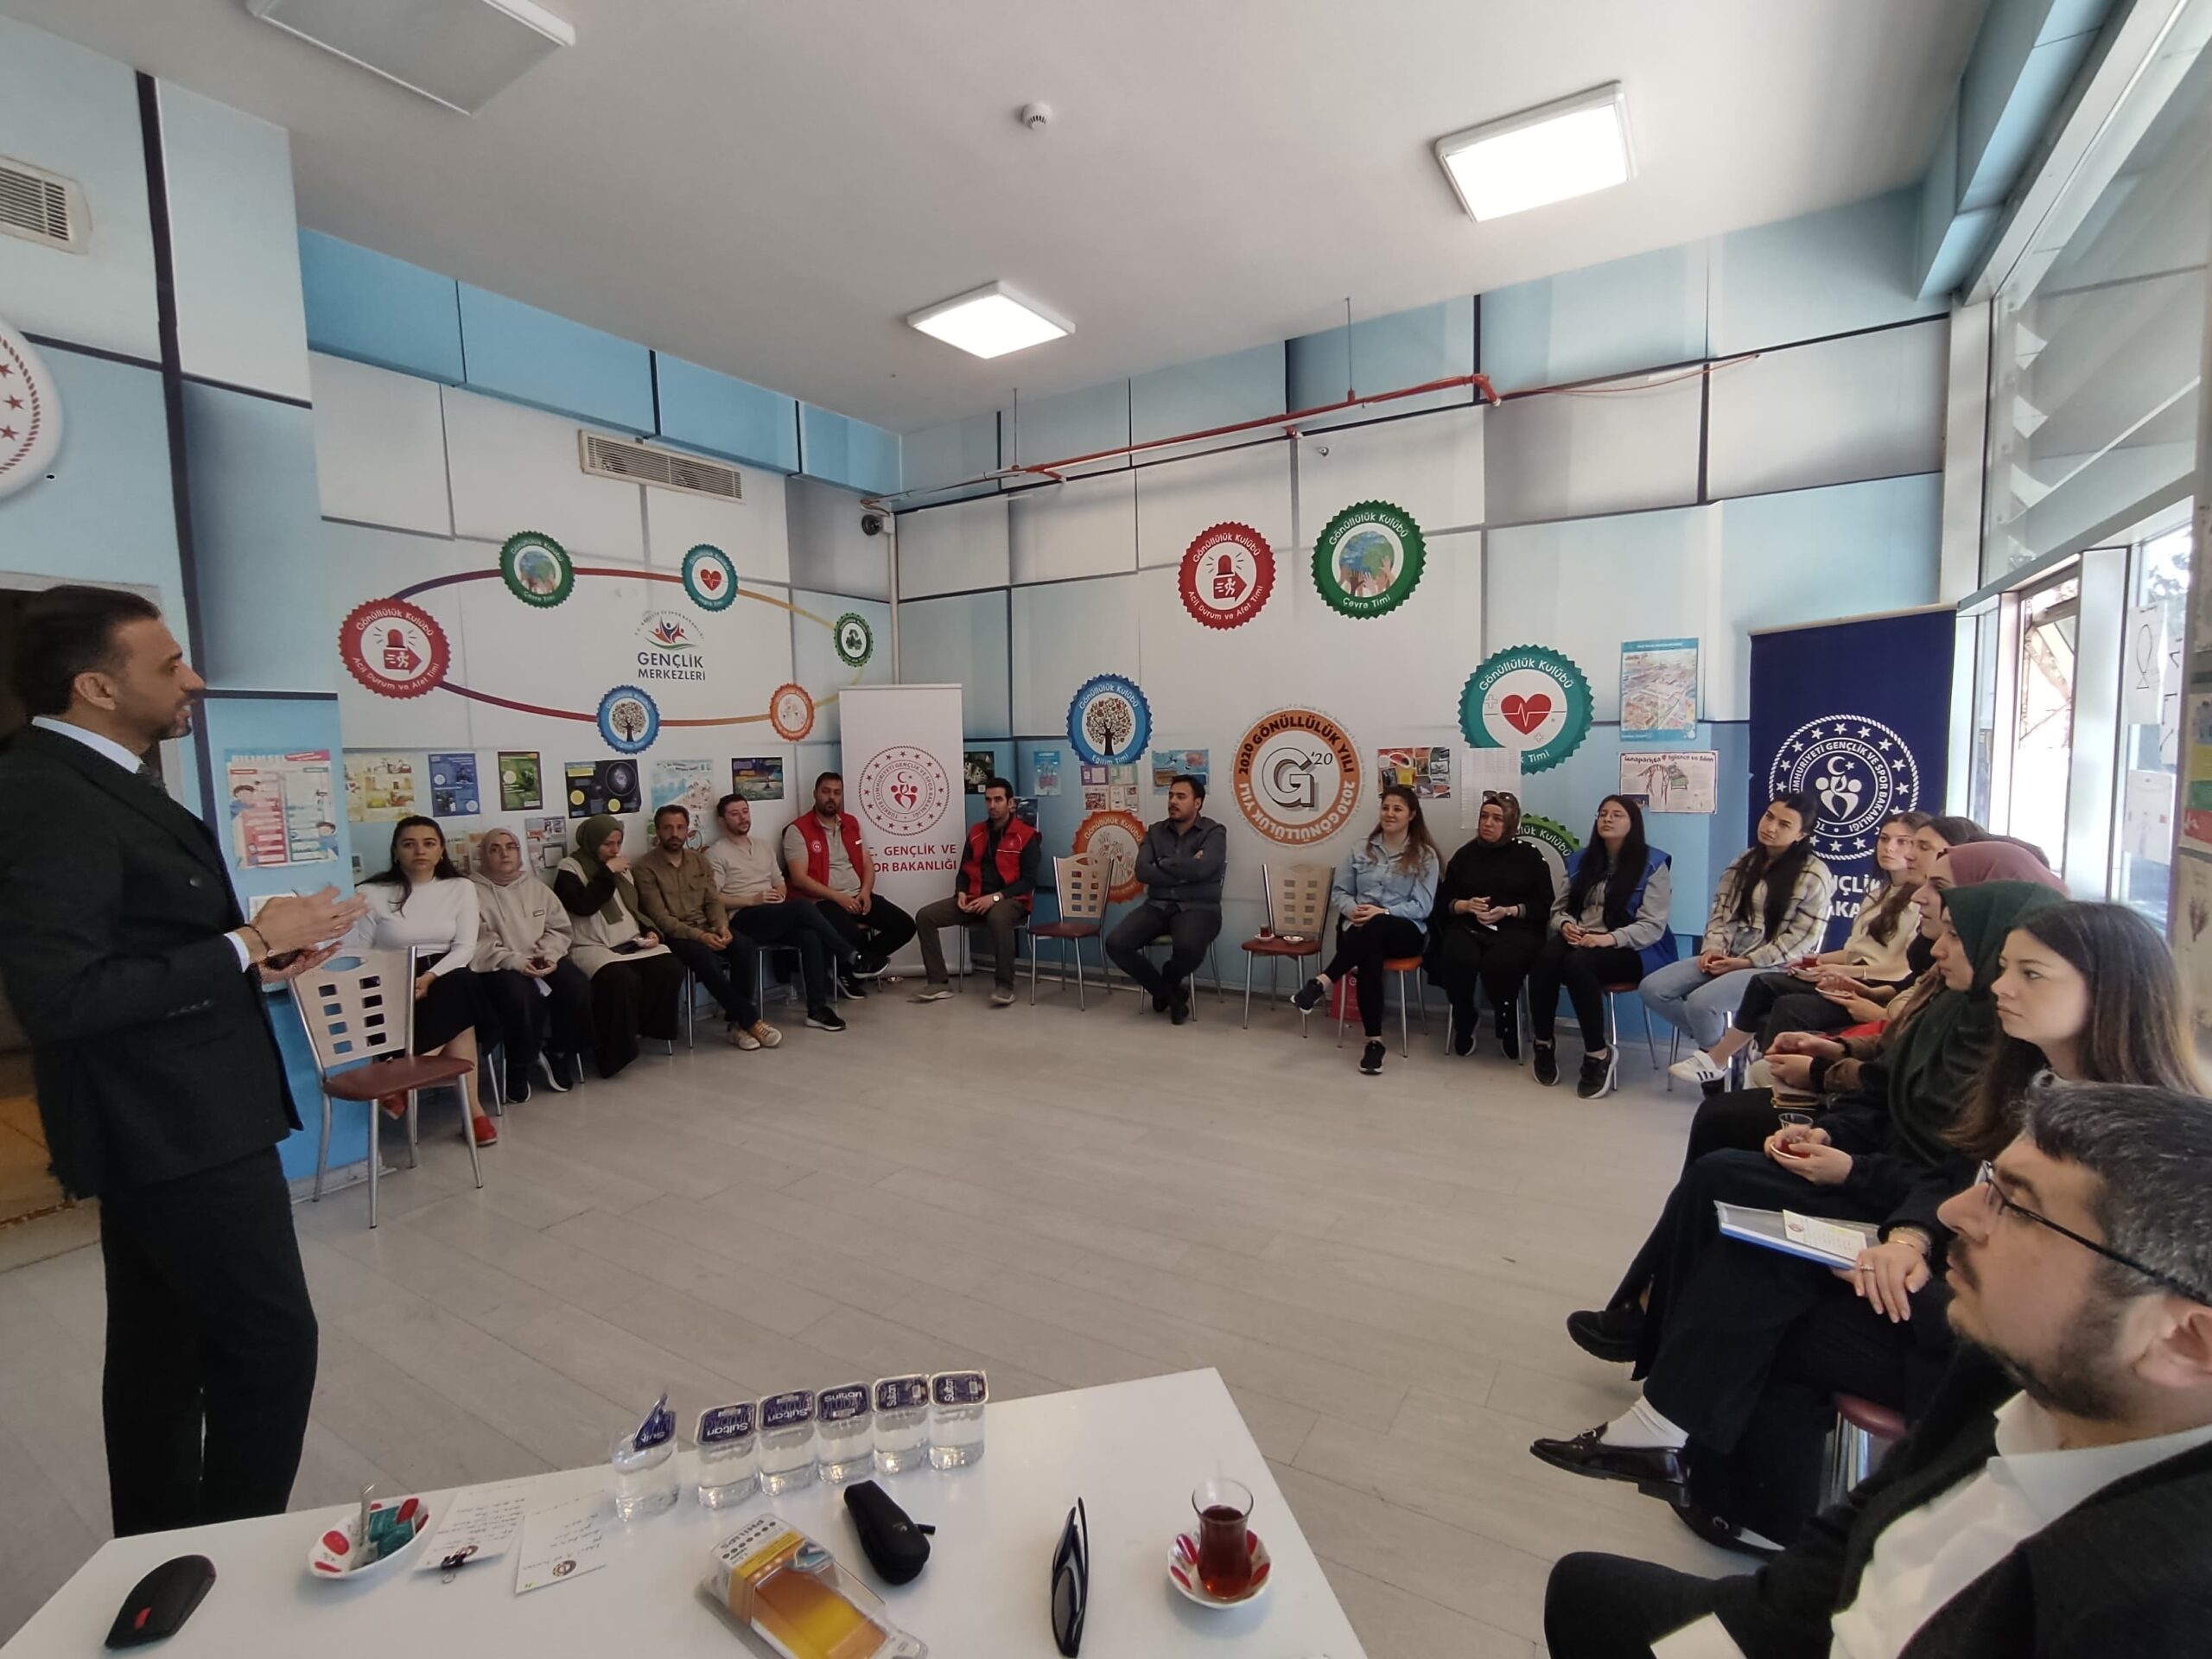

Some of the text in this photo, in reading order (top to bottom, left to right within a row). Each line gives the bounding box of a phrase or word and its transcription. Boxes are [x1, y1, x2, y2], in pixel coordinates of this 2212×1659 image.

[1329, 512, 1409, 545] Gönüllülük Kulübü
[1192, 532, 1262, 563] Gönüllülük Kulübü
[1188, 591, 1199, 606] Acil
[1198, 605, 1222, 620] Durum
[1236, 602, 1252, 617] Afet
[1343, 597, 1369, 609] Çevre
[638, 652, 703, 668] GENÇLİK
[638, 668, 706, 681] MERKEZLERİ
[1479, 657, 1575, 691] Gönüllülük Kulübü
[1238, 742, 1253, 776] 2020
[1253, 715, 1342, 747] GÖNÜLLÜLÜK
[1337, 743, 1355, 773] YILI
[1826, 741, 1868, 756] GENÇLİK
[1866, 752, 1878, 765] VE
[1874, 764, 1889, 790] SPOR
[1238, 779, 1356, 842] 2020 GÖNÜLLÜLÜK YILI
[1848, 791, 1888, 832] BAKANLIĞI
[884, 843, 936, 858] GENÇLİK
[941, 844, 957, 854] VE
[1539, 829, 1573, 857] Kulübü
[892, 858, 957, 872] BAKANLIĞI
[768, 1408, 808, 1421] Sultan
[707, 1422, 748, 1436] Sultan
